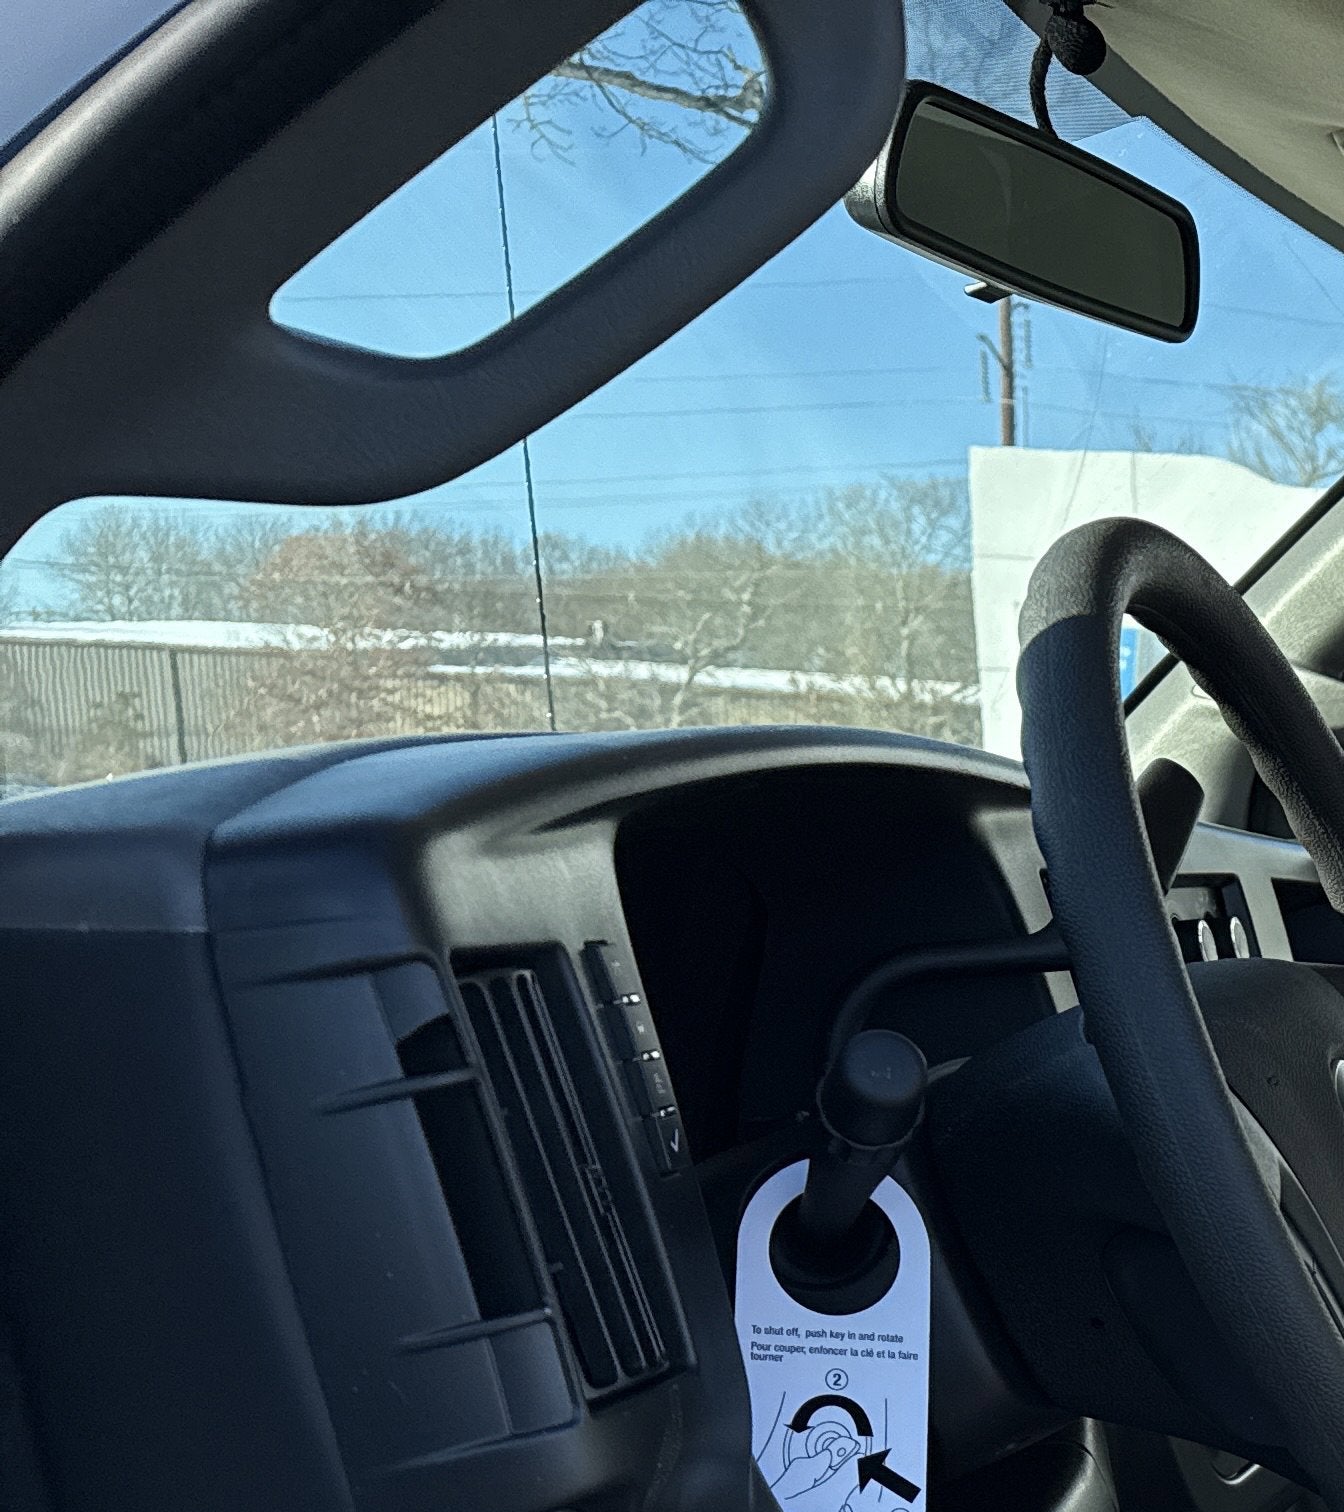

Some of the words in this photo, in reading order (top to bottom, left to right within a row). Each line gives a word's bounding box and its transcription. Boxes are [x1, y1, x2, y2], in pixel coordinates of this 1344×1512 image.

[751, 1324, 762, 1334] To
[764, 1326, 784, 1336] shut
[786, 1327, 801, 1339] off,
[805, 1329, 827, 1339] push
[830, 1330, 845, 1341] key
[858, 1332, 875, 1341] and
[877, 1333, 904, 1343] rotate
[750, 1351, 784, 1363] tourner
[751, 1341, 771, 1352] Pour
[774, 1344, 806, 1355] couper,
[809, 1346, 848, 1357] enfoncer
[860, 1347, 874, 1358] clé
[876, 1349, 886, 1359] et
[898, 1350, 919, 1361] faire
